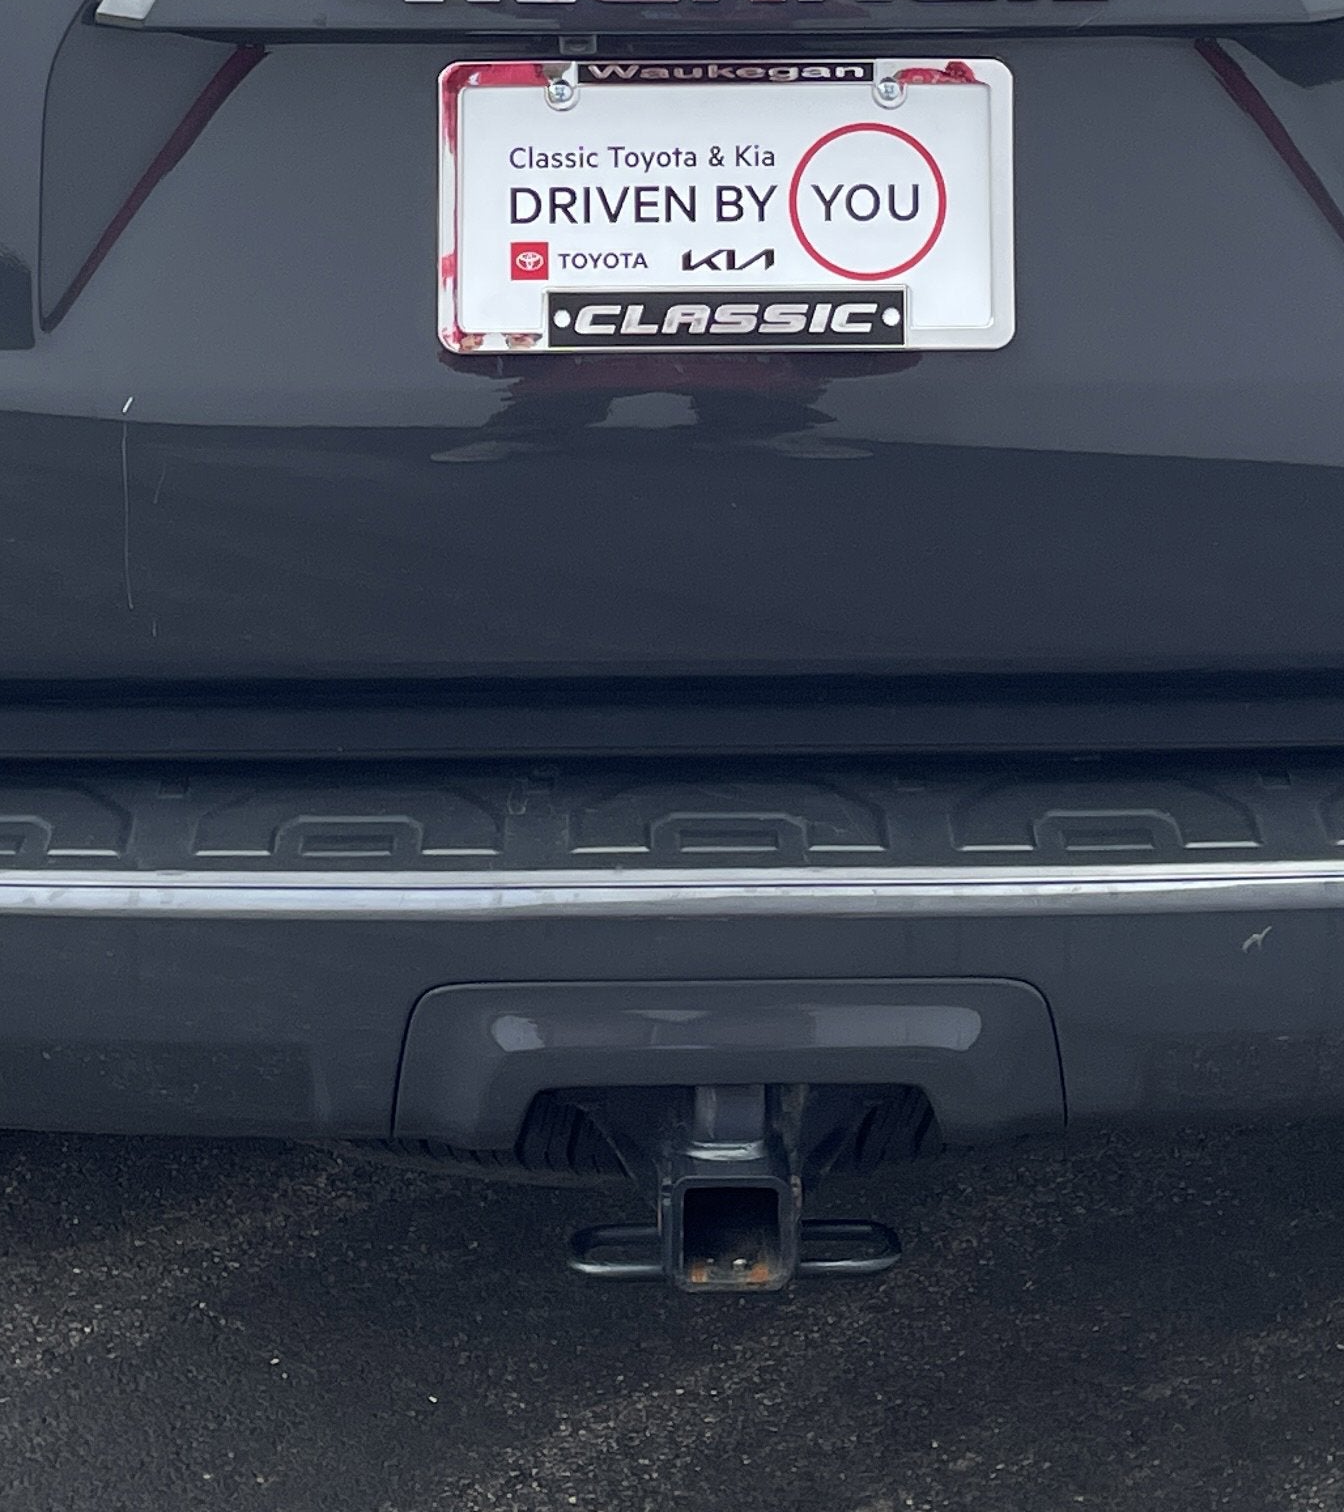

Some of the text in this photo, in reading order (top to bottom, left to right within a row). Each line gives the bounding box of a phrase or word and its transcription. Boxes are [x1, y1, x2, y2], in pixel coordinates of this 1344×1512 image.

[588, 63, 864, 82] Waukegan
[509, 145, 775, 174] Classic Toyota & Kia
[510, 184, 920, 224] DRIVEN BY YOU
[558, 248, 775, 272] TOYOTA KIA
[575, 303, 877, 335] CLASSIC
